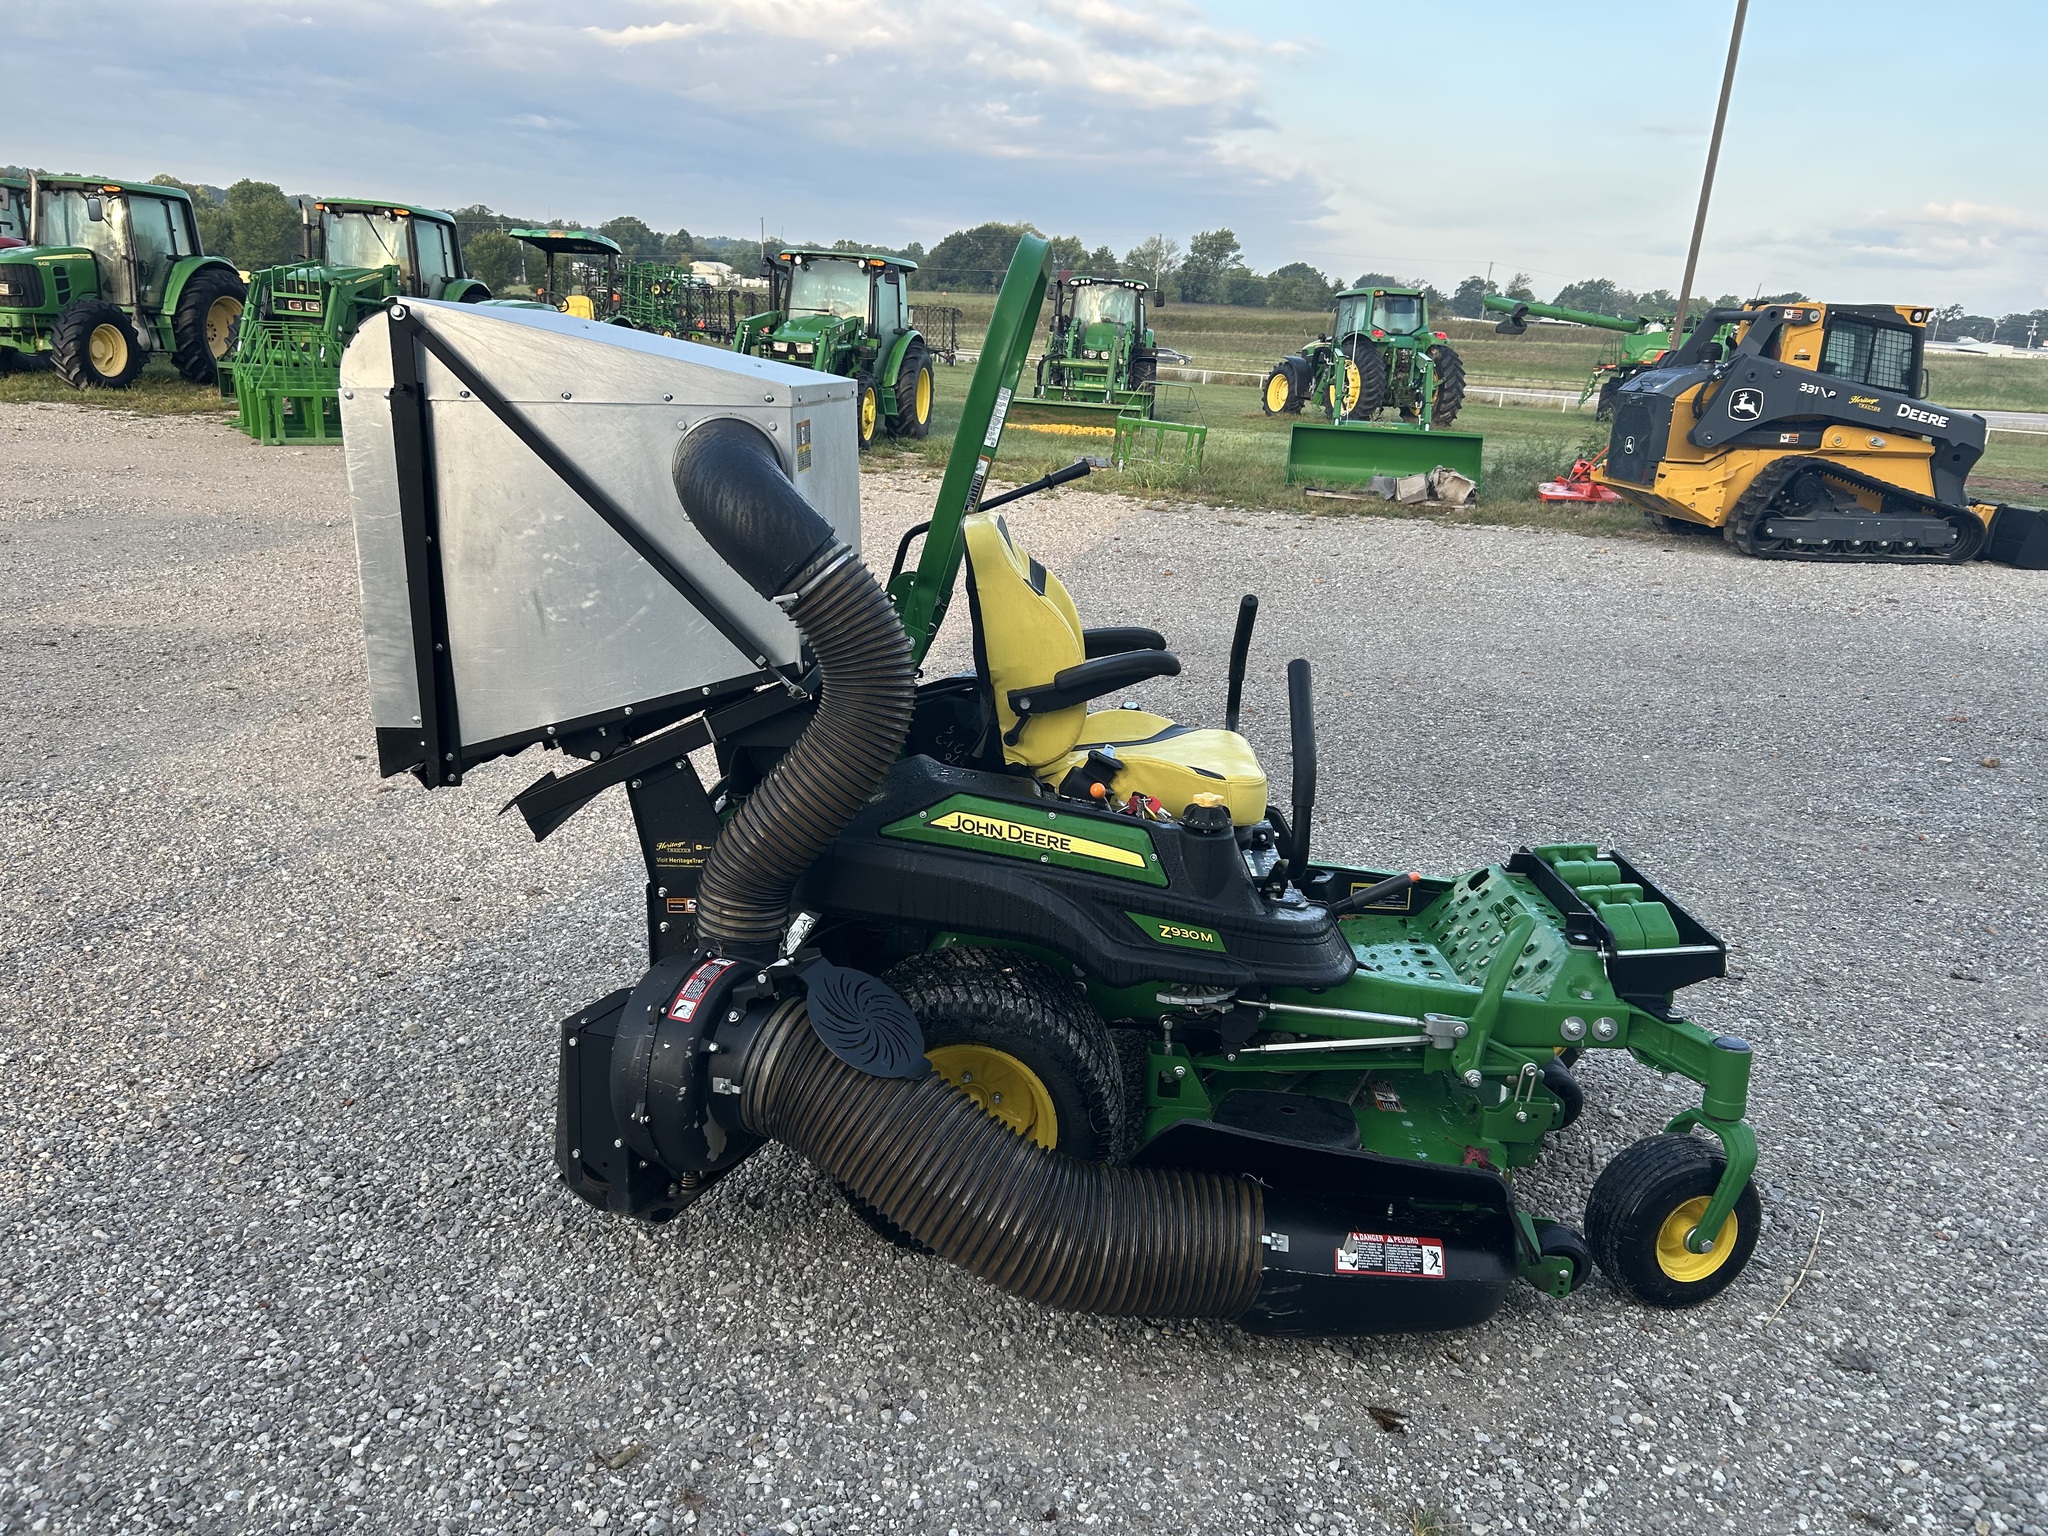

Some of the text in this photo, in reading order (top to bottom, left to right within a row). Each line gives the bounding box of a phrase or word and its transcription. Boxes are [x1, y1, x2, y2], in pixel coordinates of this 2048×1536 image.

[1848, 395, 1880, 405] Heritage
[1896, 403, 1949, 428] DEERE
[950, 815, 1071, 851] JOHN DEERE
[655, 841, 685, 851] Heritage
[1158, 924, 1214, 943] Z930M
[1359, 1233, 1419, 1244] DANGER PELIGRO
